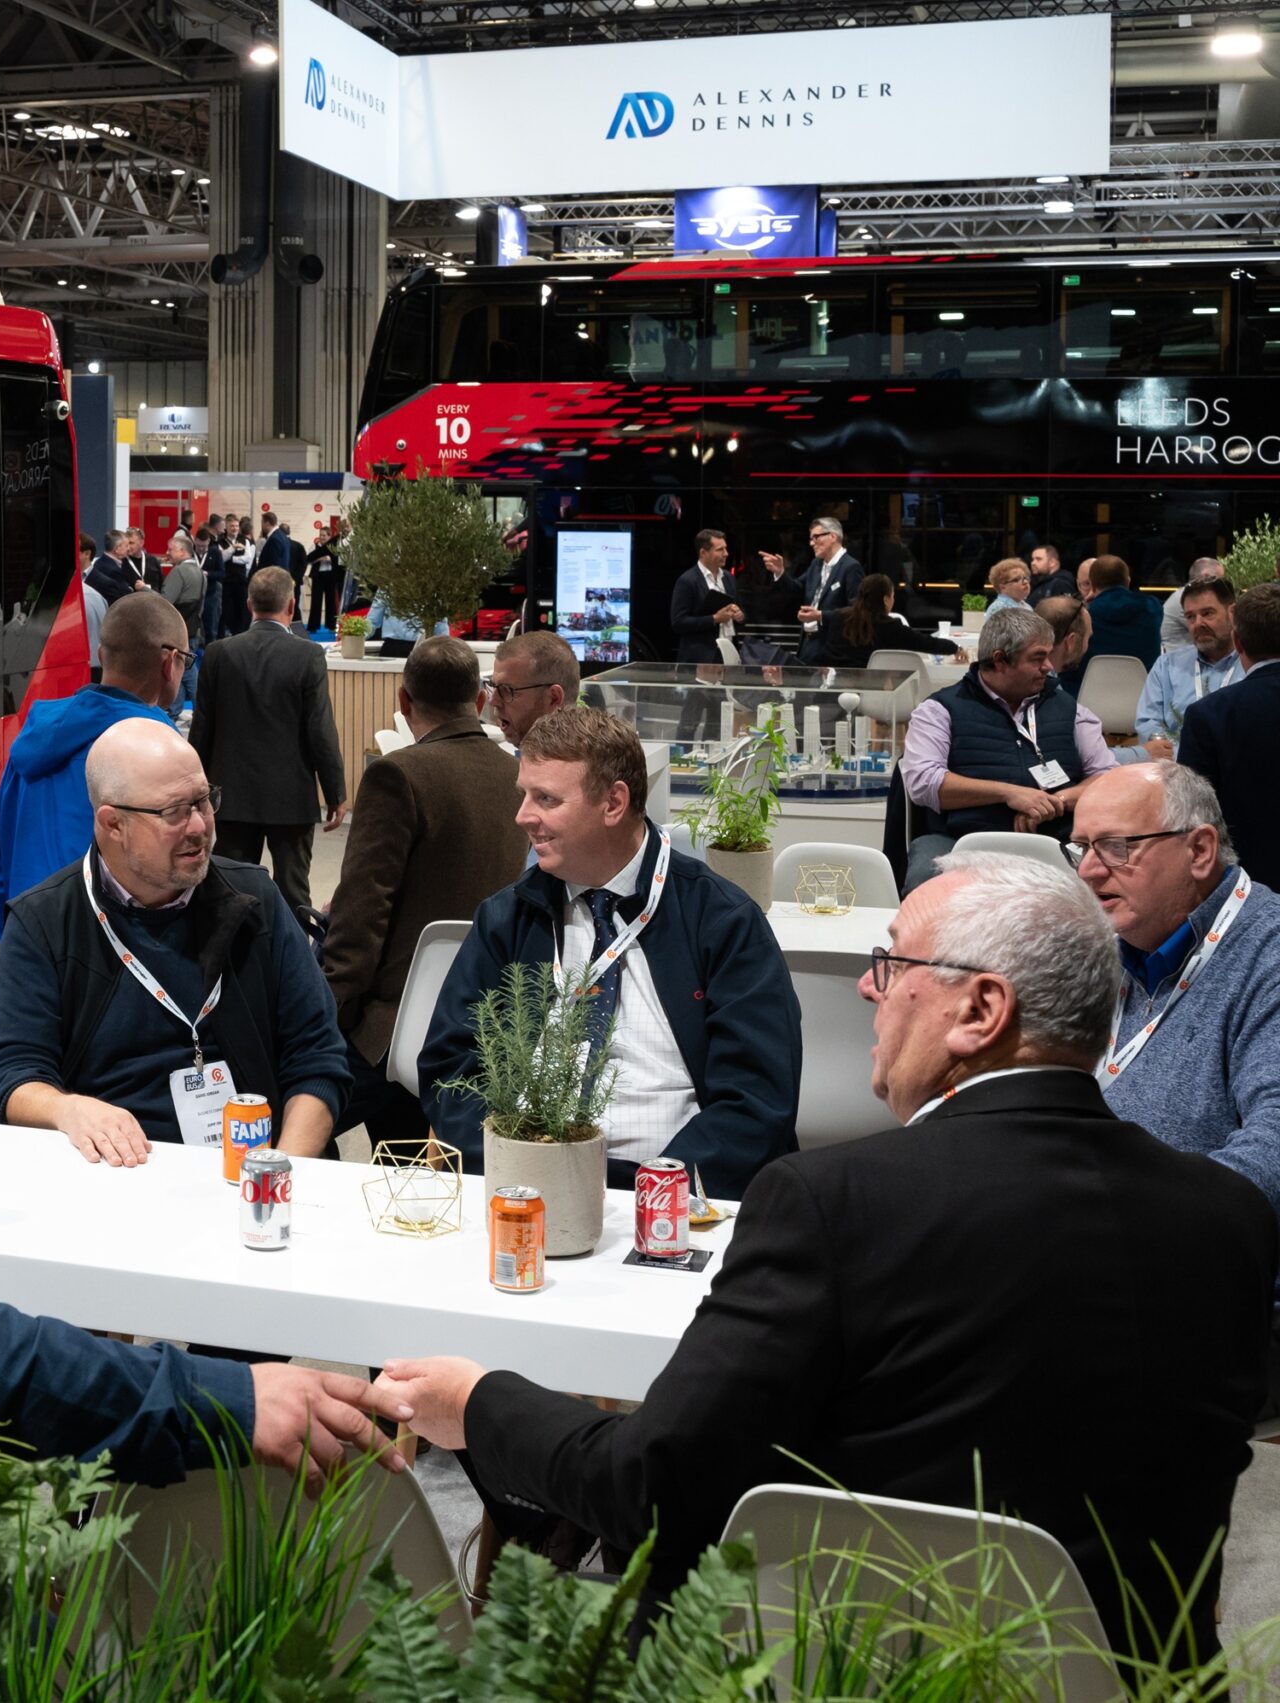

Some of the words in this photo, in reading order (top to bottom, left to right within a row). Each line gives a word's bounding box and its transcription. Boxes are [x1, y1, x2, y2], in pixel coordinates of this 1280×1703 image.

[330, 73, 385, 115] ALEXANDER
[693, 82, 893, 106] ALEXANDER
[330, 98, 366, 129] DENNIS
[692, 112, 813, 132] DENNIS
[437, 404, 470, 414] EVERY
[1117, 397, 1230, 426] LEEDS
[435, 416, 471, 445] 10
[438, 449, 469, 459] MINS
[1117, 436, 1280, 464] HARROG
[185, 1073, 203, 1085] EURO
[186, 1082, 198, 1091] BUS
[241, 1173, 293, 1205] oke
